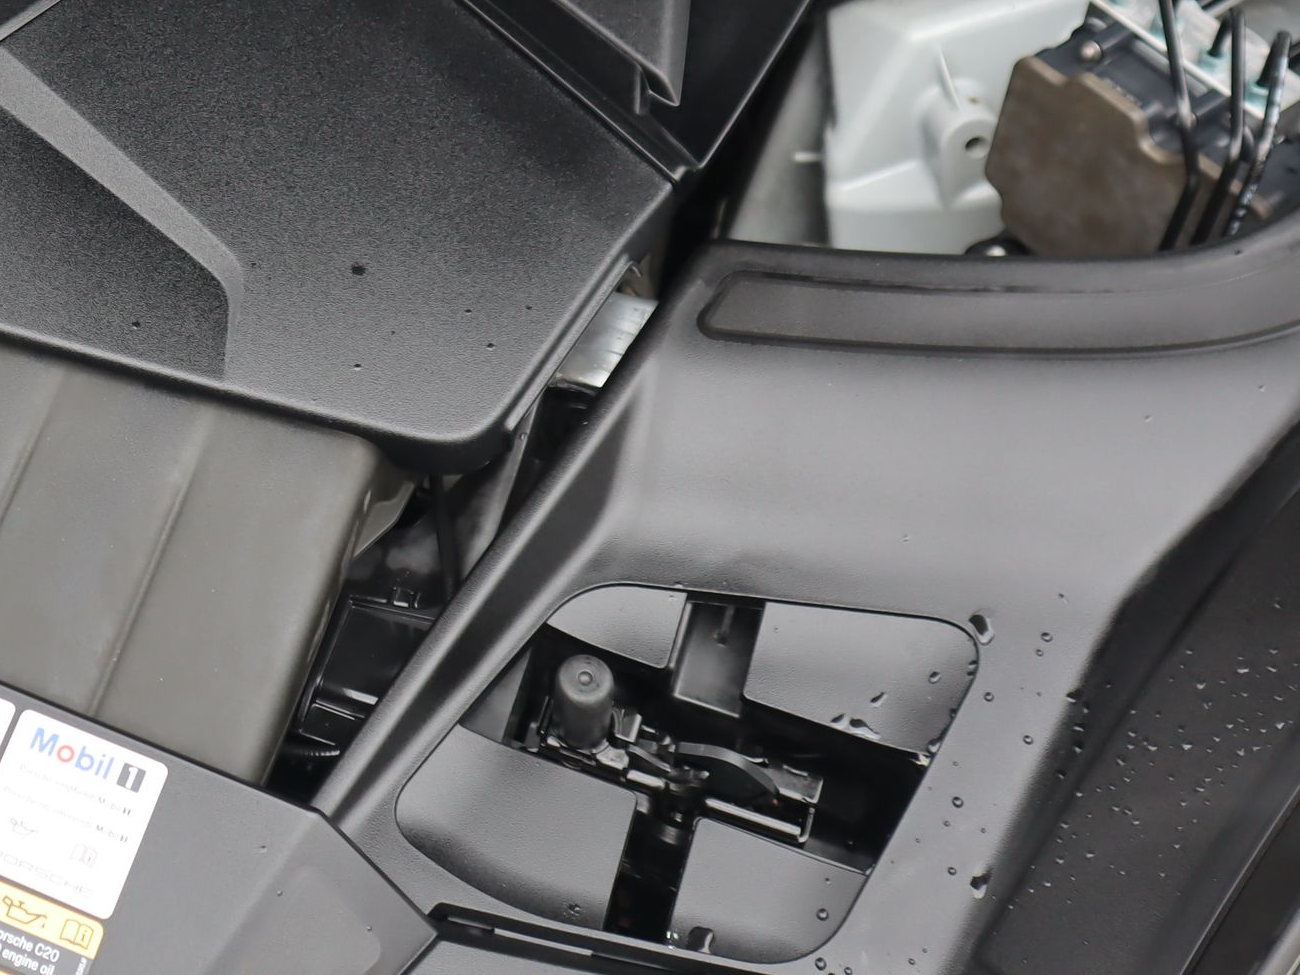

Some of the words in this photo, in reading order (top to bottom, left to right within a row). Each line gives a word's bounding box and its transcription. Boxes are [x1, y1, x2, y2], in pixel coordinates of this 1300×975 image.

[29, 727, 115, 779] Mobil
[2, 949, 39, 971] engine
[40, 964, 56, 975] oil
[34, 943, 60, 963] C20
